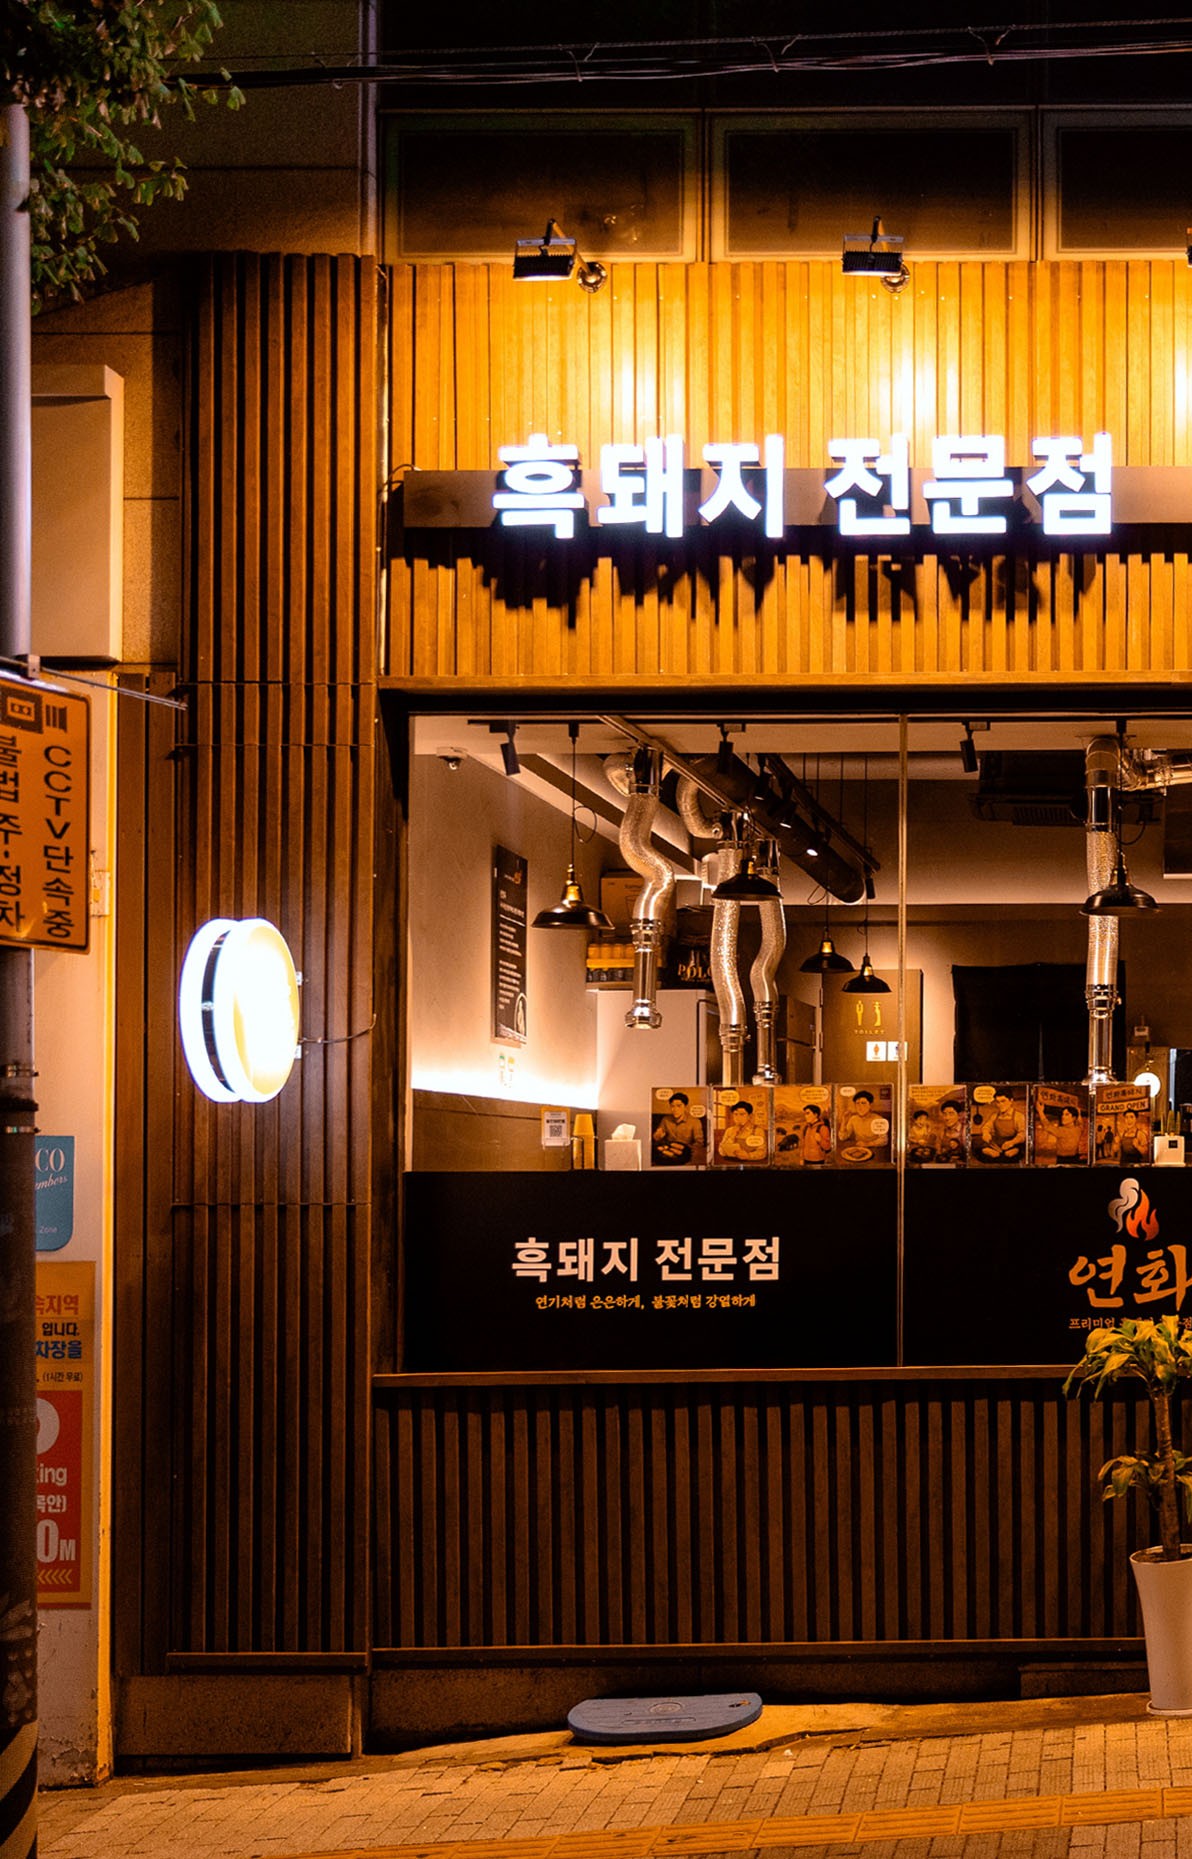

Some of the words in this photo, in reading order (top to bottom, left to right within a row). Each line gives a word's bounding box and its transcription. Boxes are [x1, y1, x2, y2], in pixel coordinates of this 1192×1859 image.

[491, 433, 785, 539] 흑돼지
[823, 431, 1114, 537] 전문점
[1100, 1102, 1125, 1111] GRAND
[1126, 1100, 1147, 1110] OPEN
[35, 1147, 66, 1173] CO
[511, 1236, 639, 1283] 흑돼지
[655, 1236, 780, 1281] 전문점
[535, 1294, 587, 1309] 연기처럼
[590, 1294, 645, 1310] 은은하게,
[651, 1294, 702, 1309] 불꽃처럼
[1069, 1316, 1116, 1331] 프리미엄
